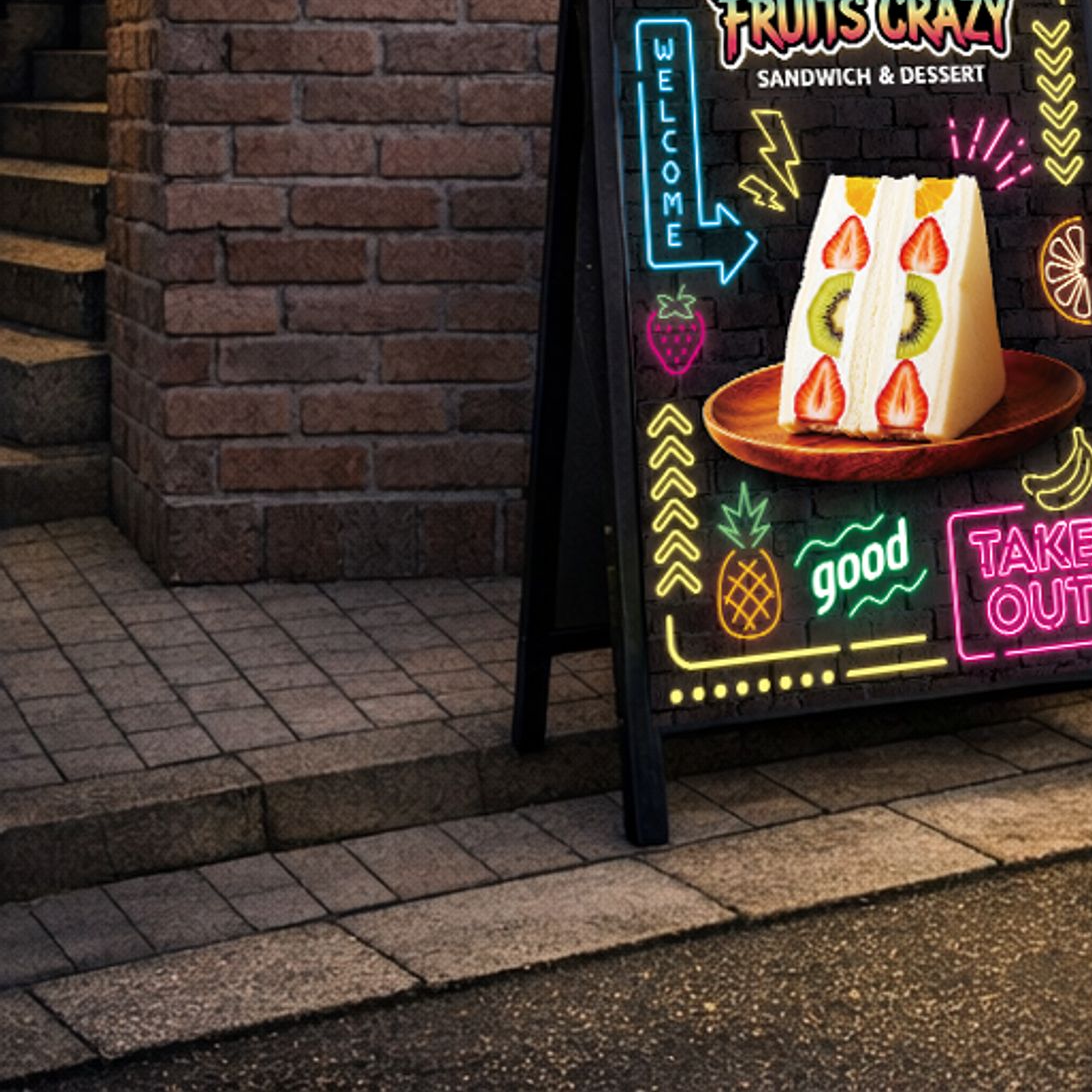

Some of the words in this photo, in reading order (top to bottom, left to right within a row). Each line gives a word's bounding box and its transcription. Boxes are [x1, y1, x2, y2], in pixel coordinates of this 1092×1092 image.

[757, 67, 872, 89] SANDWICH
[878, 66, 895, 85] &
[900, 63, 985, 86] DESSERT
[654, 37, 683, 248] WELCOME
[811, 516, 910, 616] good
